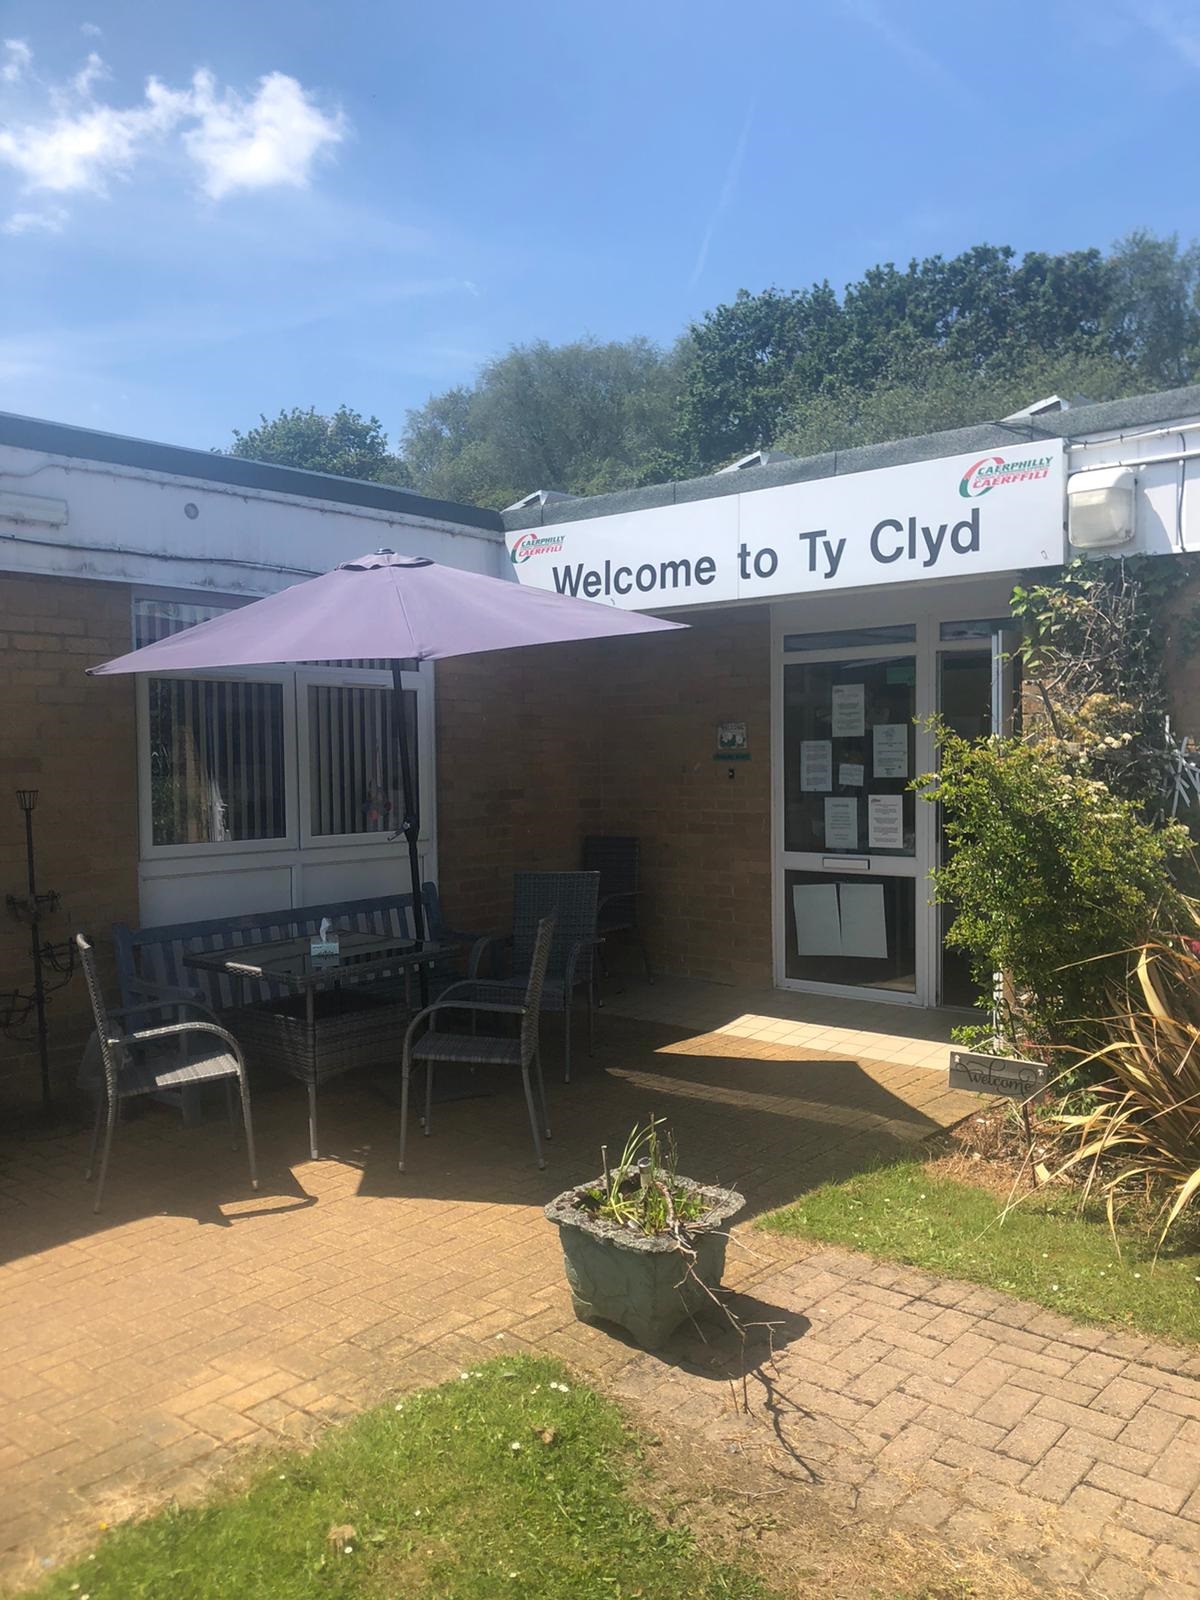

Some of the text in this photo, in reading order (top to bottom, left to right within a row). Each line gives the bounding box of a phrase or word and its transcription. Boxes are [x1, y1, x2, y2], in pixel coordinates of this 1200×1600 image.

[977, 456, 1053, 476] CAERPHILLY
[972, 470, 1049, 488] CAERFFILI
[521, 535, 565, 547] CAERPHILLY
[518, 545, 563, 557] CAERFFILI
[552, 508, 980, 598] Welcome to Ty Clyd
